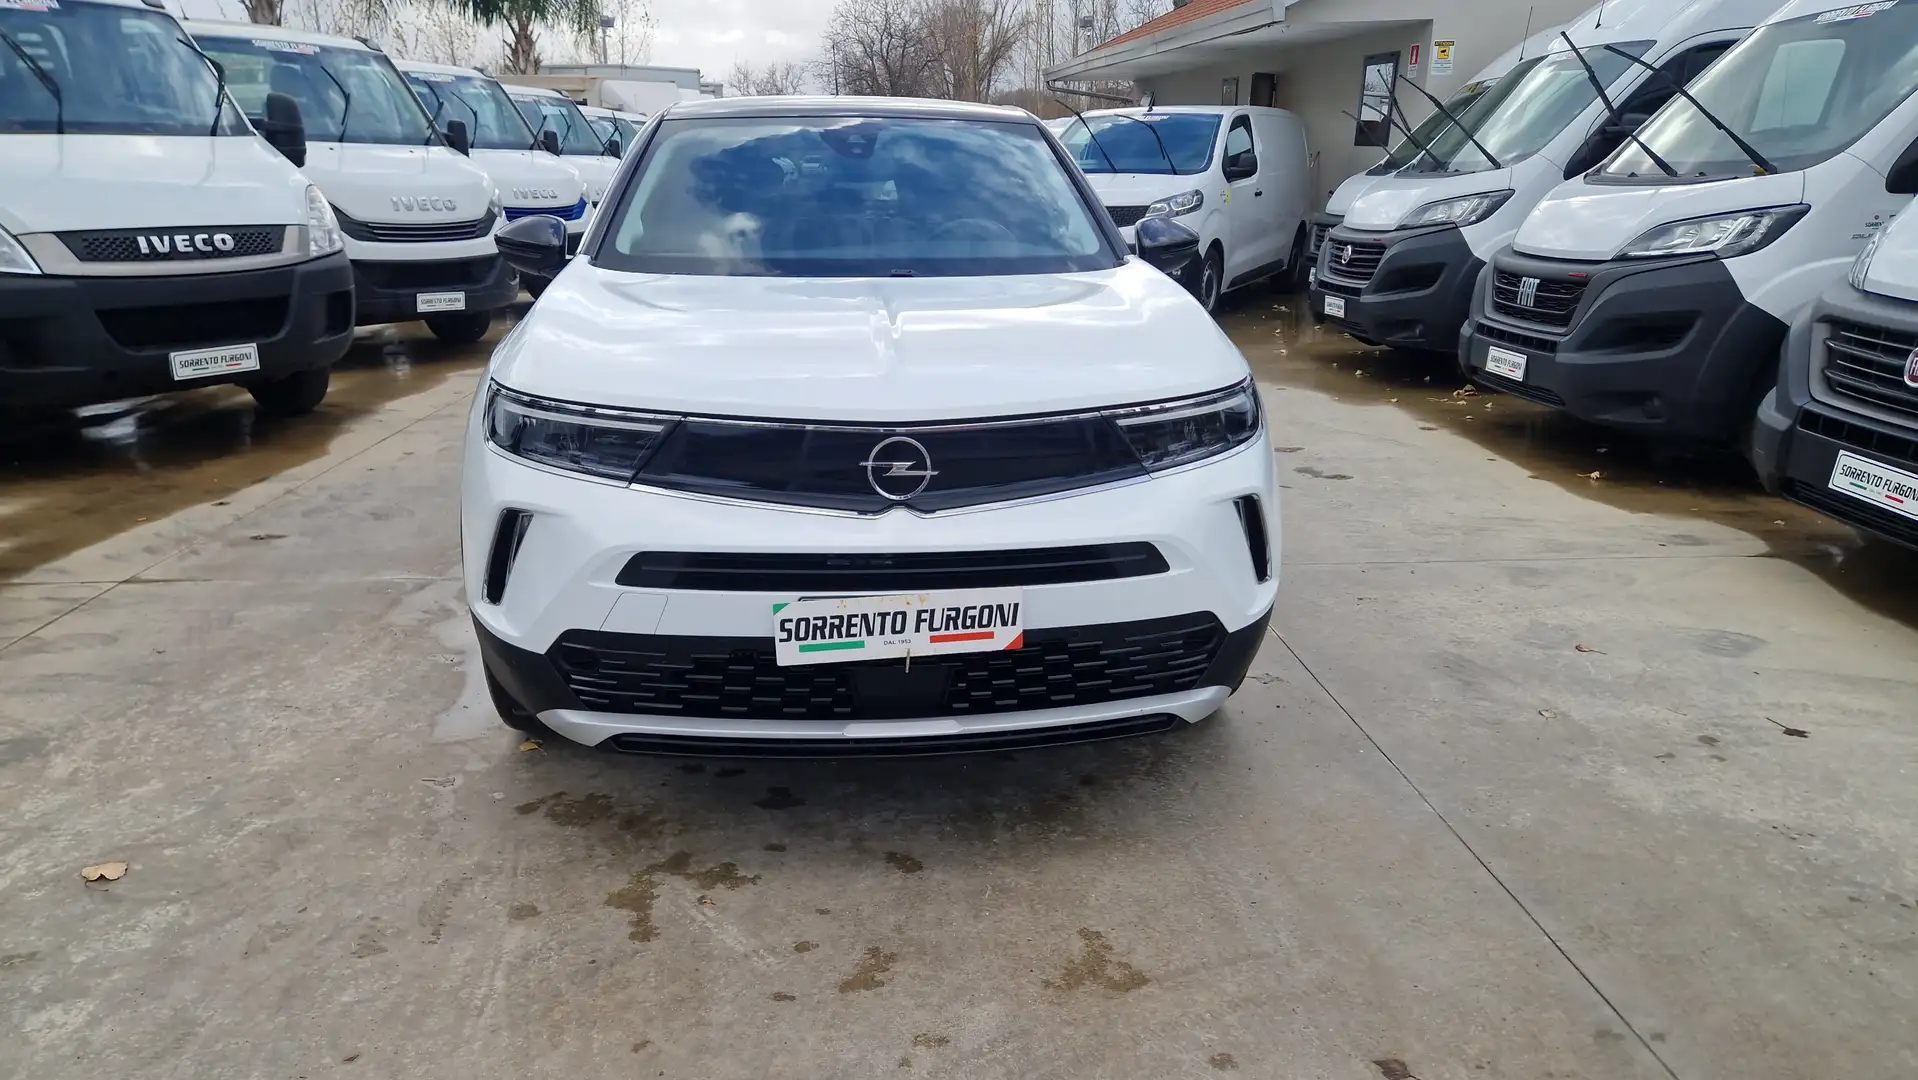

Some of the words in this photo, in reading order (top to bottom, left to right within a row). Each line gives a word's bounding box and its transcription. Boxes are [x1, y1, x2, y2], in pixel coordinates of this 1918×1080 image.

[391, 196, 457, 212] IVECO
[511, 187, 558, 200] IVECO
[136, 233, 235, 254] IVECO
[1517, 276, 1540, 307] FIAT
[179, 356, 219, 369] SORRENTO
[220, 352, 252, 364] FURGONI
[1839, 464, 1884, 488] SORRENTO
[1882, 479, 1918, 502] FURGON
[778, 609, 907, 643] SORRENTO
[914, 602, 1020, 633] FURGONI
